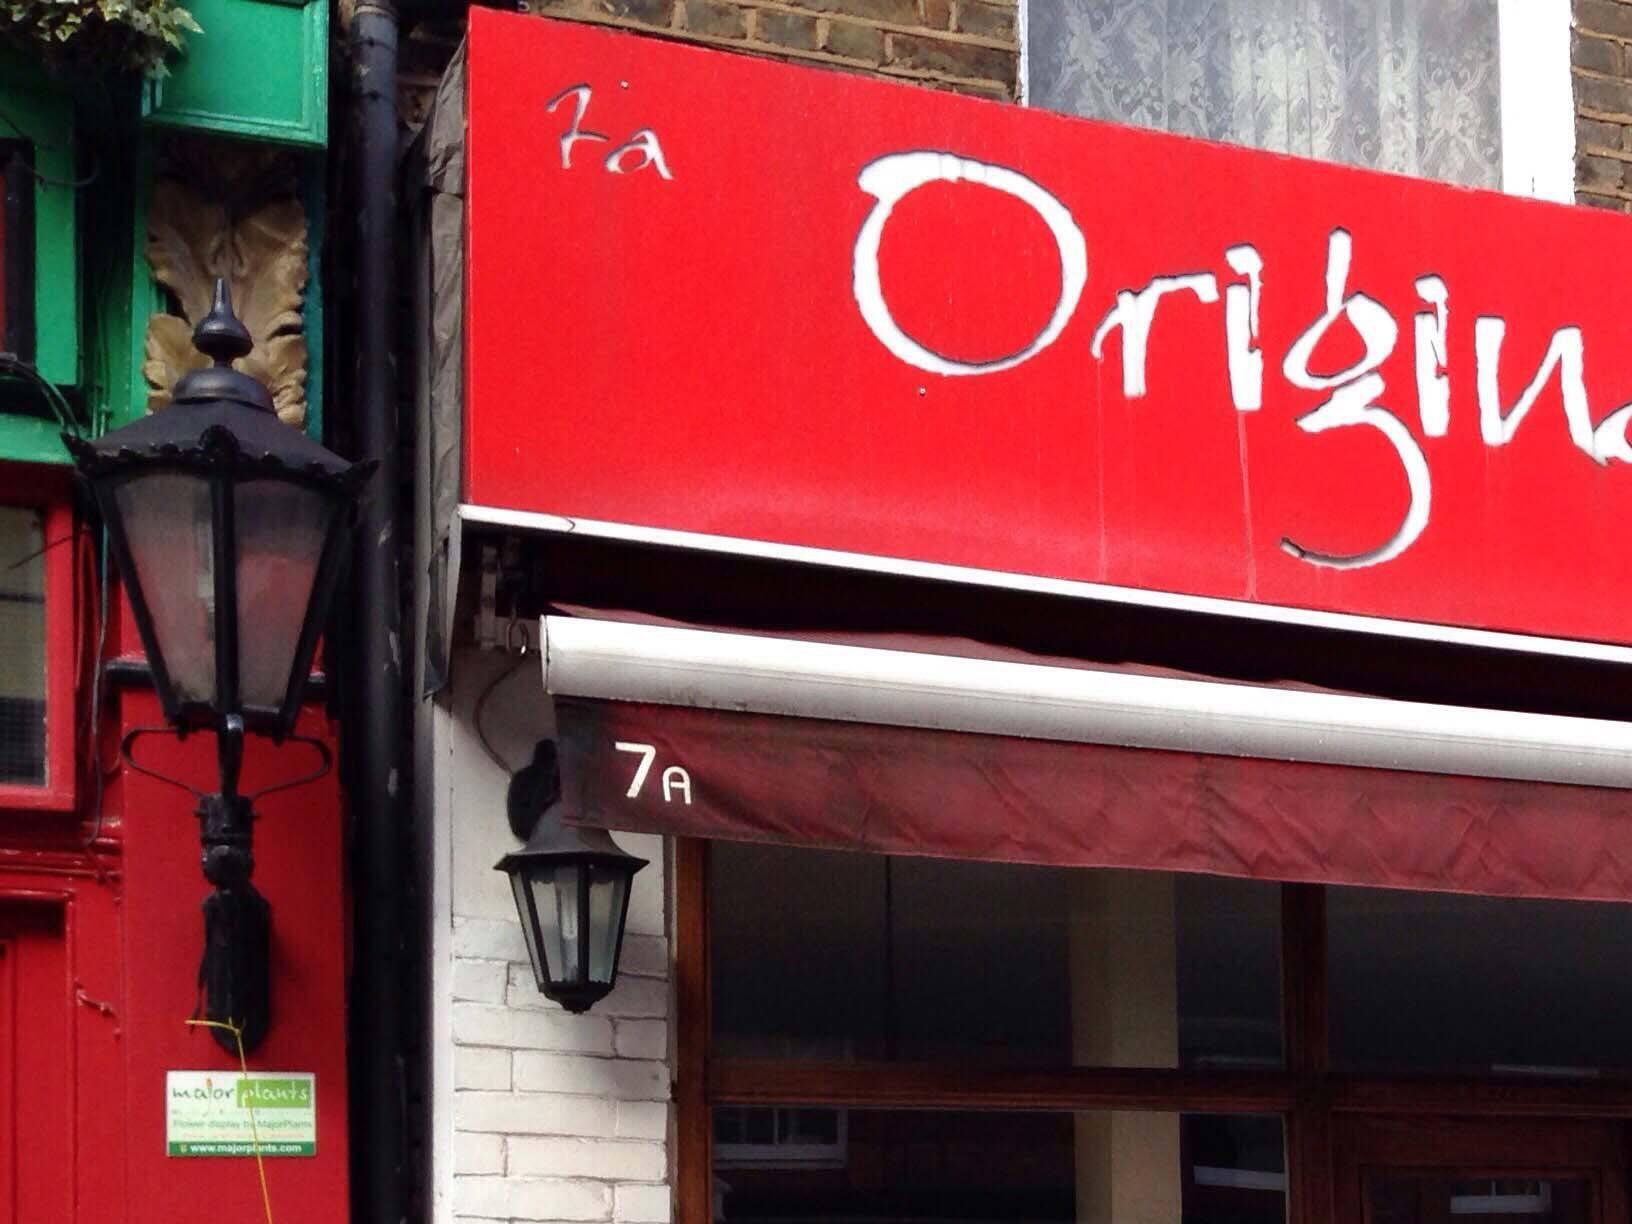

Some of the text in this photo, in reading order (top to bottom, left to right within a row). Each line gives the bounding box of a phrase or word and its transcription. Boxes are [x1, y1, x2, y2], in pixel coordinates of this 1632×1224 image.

[546, 82, 674, 181] 7a
[614, 740, 692, 805] 7A
[172, 1078, 308, 1108] major plants
[190, 1143, 303, 1155] www.majorplants.com
